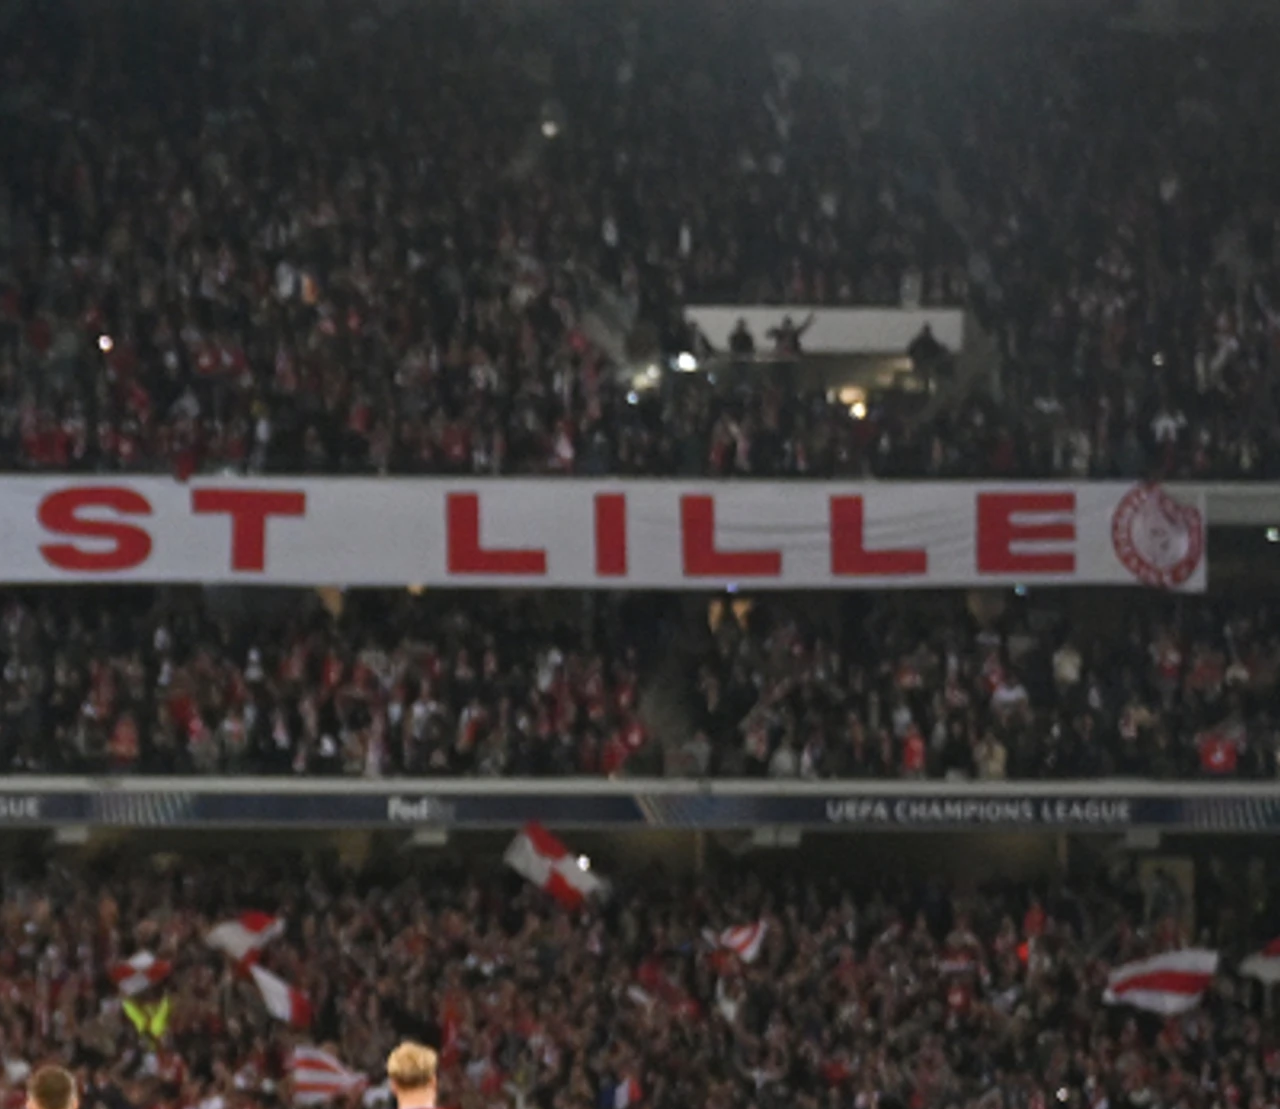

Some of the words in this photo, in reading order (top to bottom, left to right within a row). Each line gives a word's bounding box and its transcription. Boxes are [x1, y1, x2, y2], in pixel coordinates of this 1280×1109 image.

[446, 491, 1077, 577] LILLE
[825, 799, 889, 822] UEFA
[894, 799, 1034, 822] CHAMPIONS
[1040, 799, 1130, 822] LEAGUE
